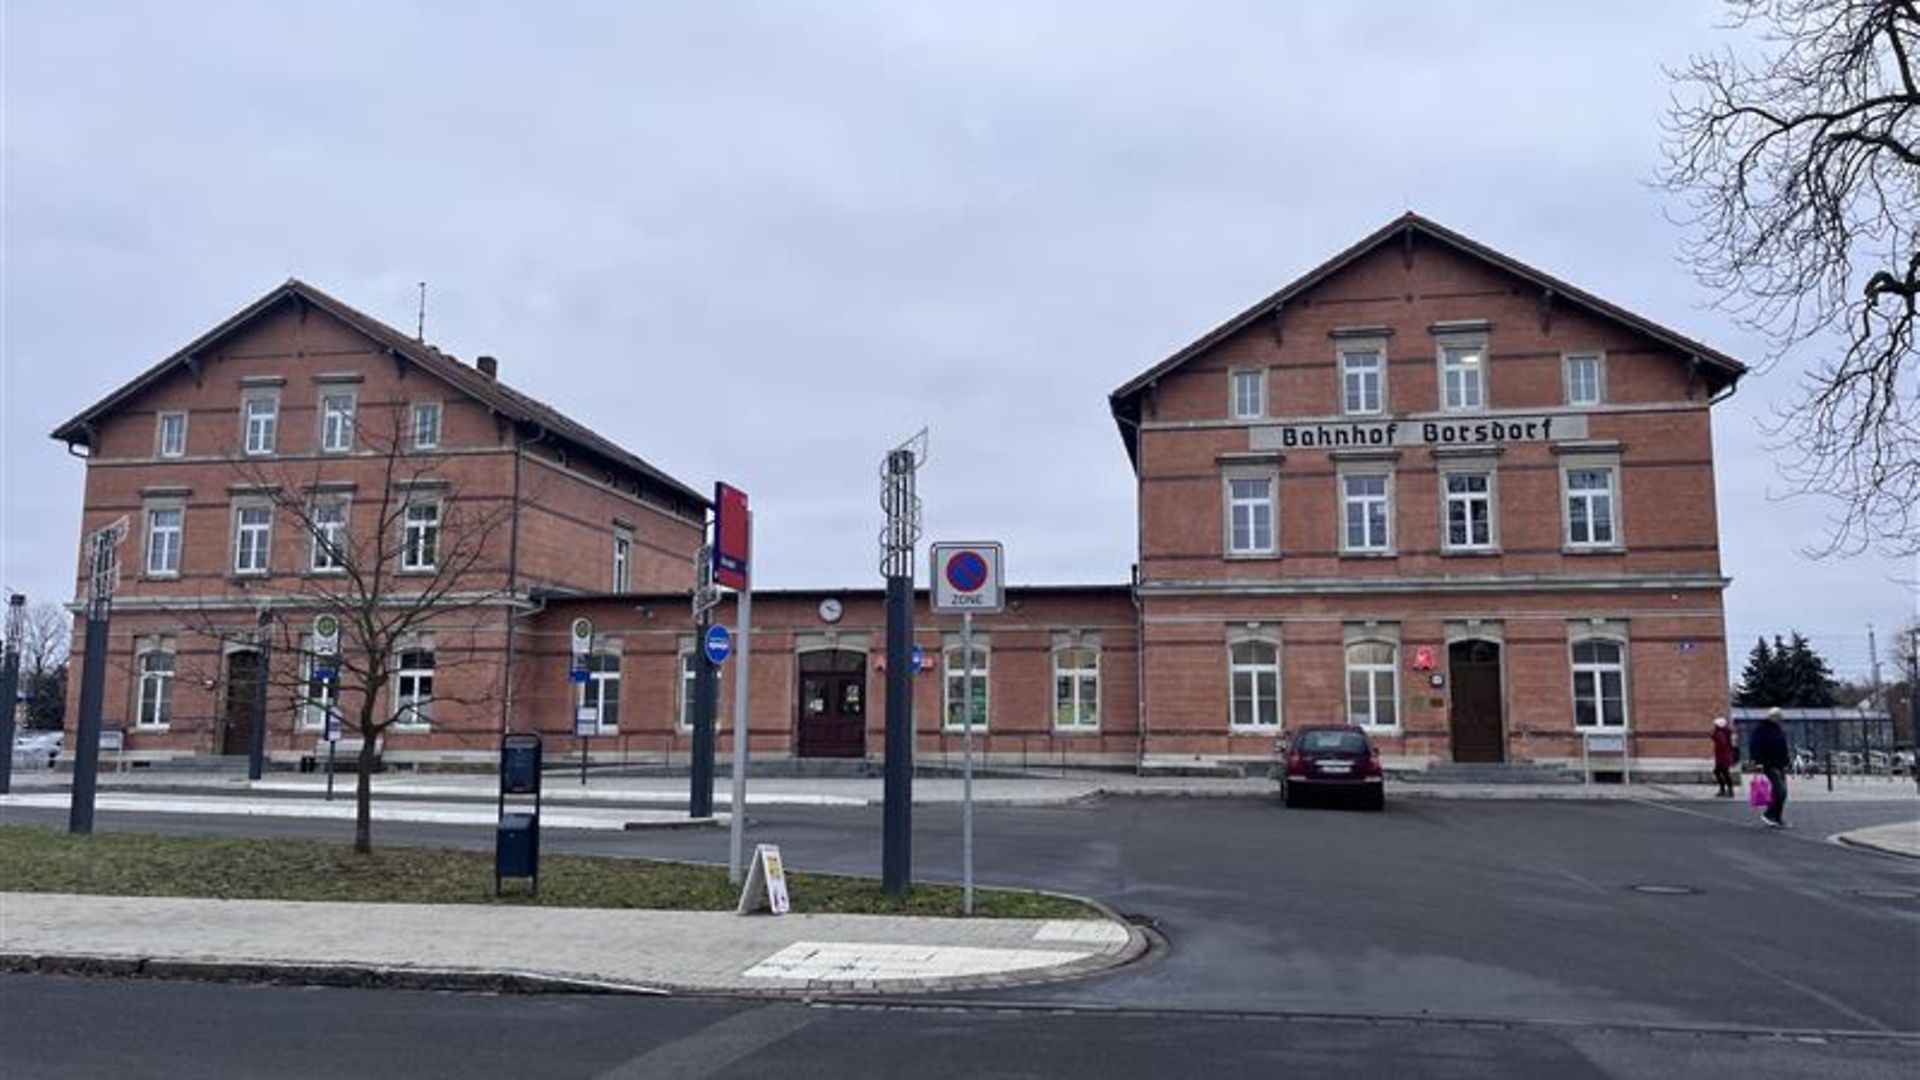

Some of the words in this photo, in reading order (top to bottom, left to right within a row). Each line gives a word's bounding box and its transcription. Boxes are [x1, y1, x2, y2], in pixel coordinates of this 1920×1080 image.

[1282, 424, 1398, 447] Bahnhof
[1423, 418, 1553, 443] Borsdorf
[951, 594, 983, 605] ZONE
